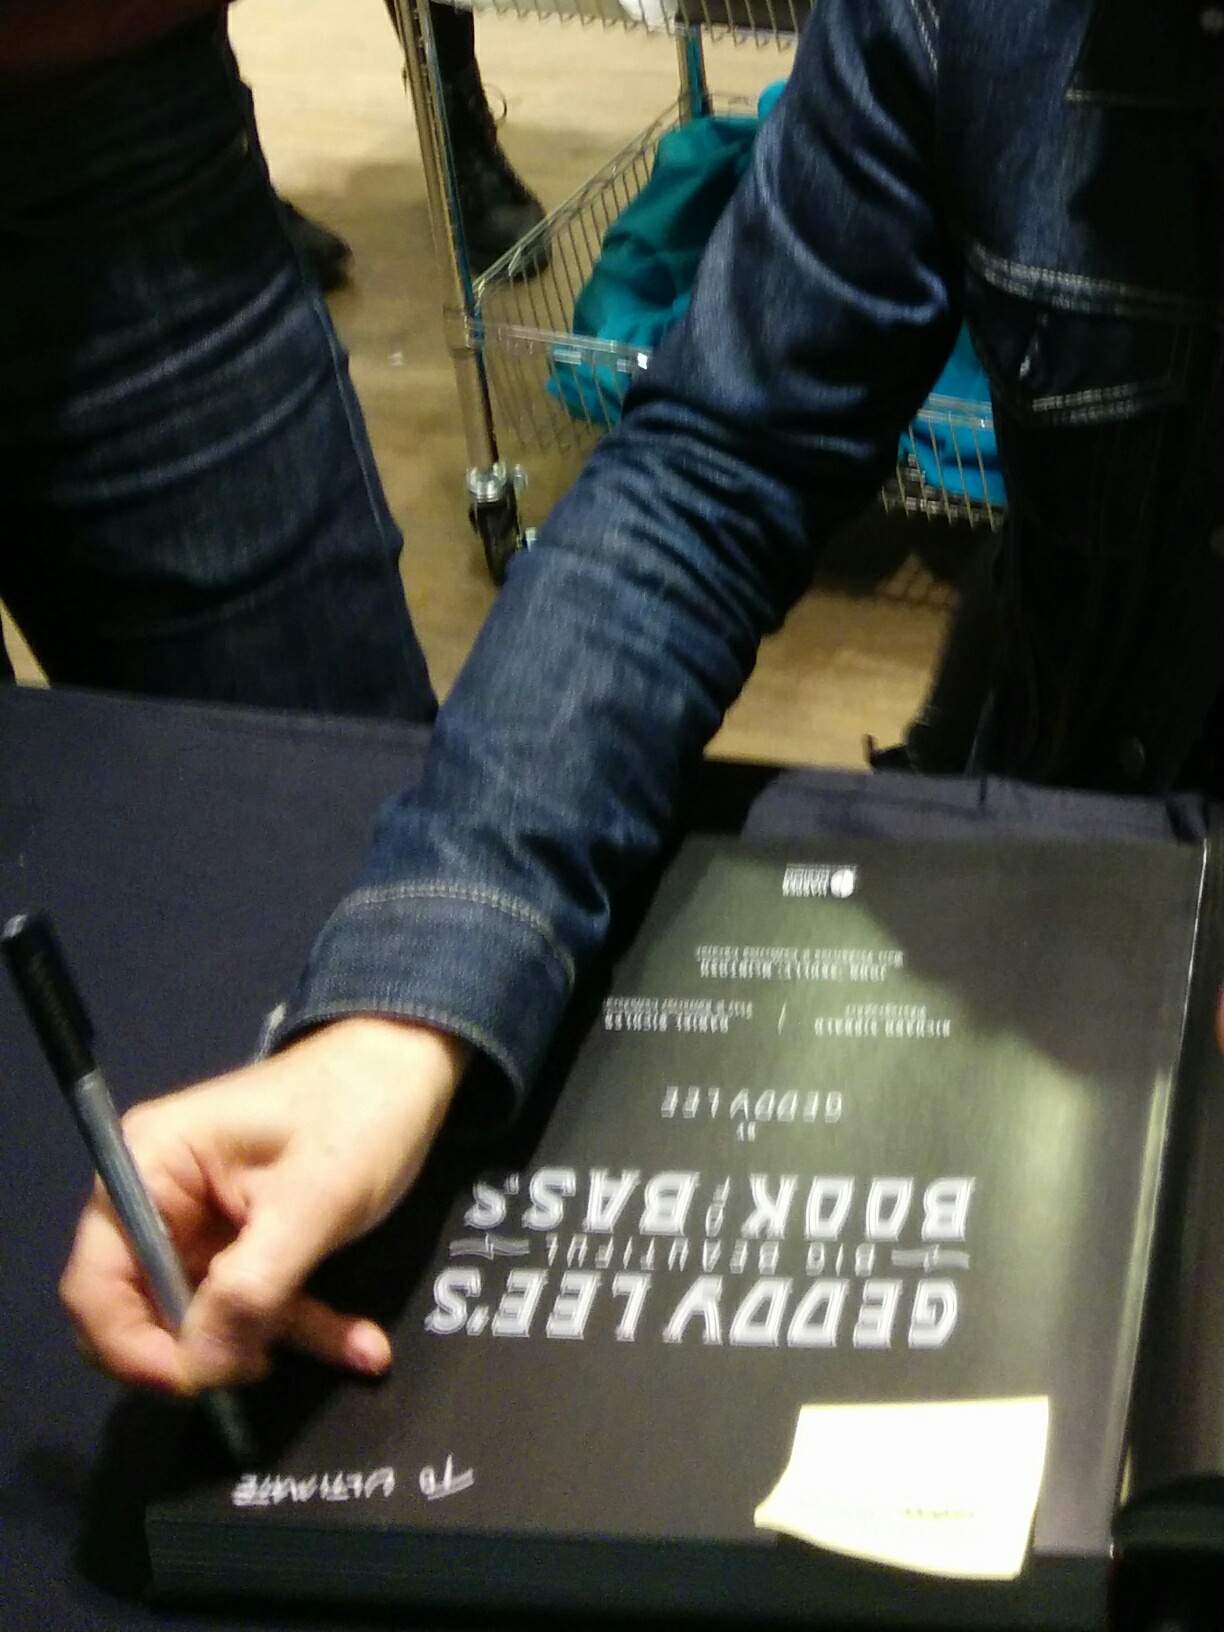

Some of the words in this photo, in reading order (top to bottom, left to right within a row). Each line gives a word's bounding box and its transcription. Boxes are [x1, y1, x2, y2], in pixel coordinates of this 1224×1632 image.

[661, 1086, 720, 1119] LEE
[729, 1087, 843, 1124] GEDDY
[463, 1165, 700, 1238] BASS
[742, 1172, 976, 1242] BOOK
[545, 1234, 780, 1277] BEAUTIFUL
[805, 1241, 876, 1278] BIG
[424, 1266, 651, 1343] LEE'S
[662, 1274, 959, 1350] GEDDY
[418, 1452, 475, 1502] TO
